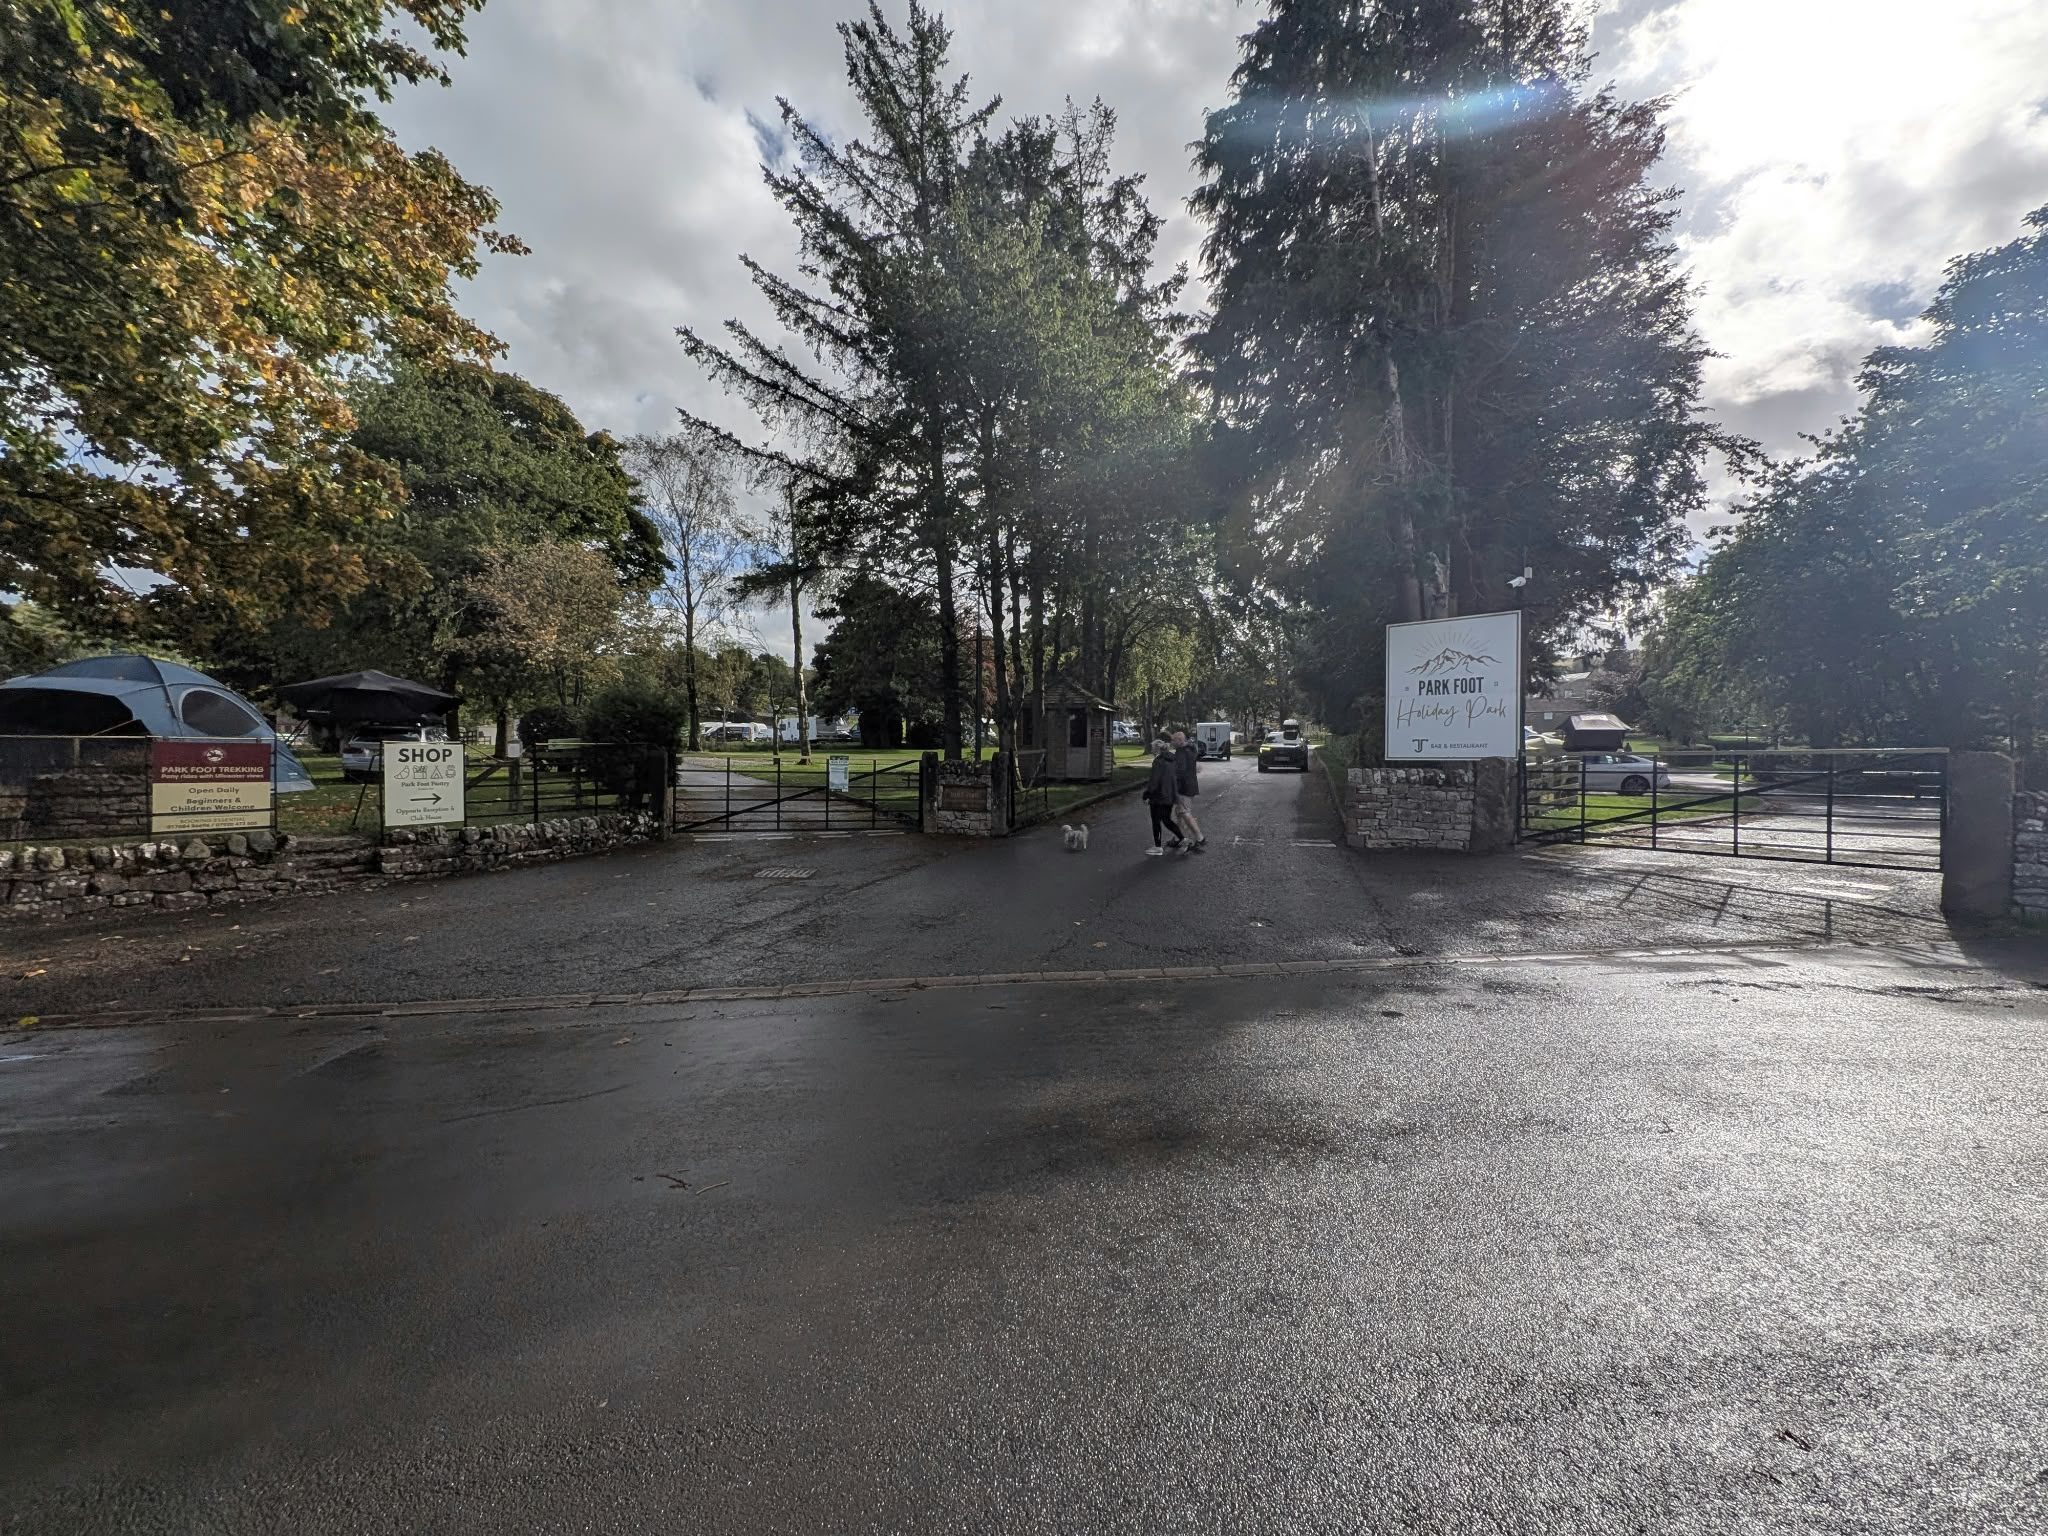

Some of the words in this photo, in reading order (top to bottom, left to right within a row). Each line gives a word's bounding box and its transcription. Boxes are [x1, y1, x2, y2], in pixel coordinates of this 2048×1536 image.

[1418, 678, 1450, 696] PARK
[1453, 677, 1485, 695] FOOT
[1396, 698, 1459, 730] Holiday
[1465, 695, 1507, 729] Park
[398, 748, 453, 763] SHOP
[161, 766, 188, 774] PARK
[190, 766, 217, 774] FOOT
[188, 787, 214, 795] Open
[186, 798, 232, 806] Beginners
